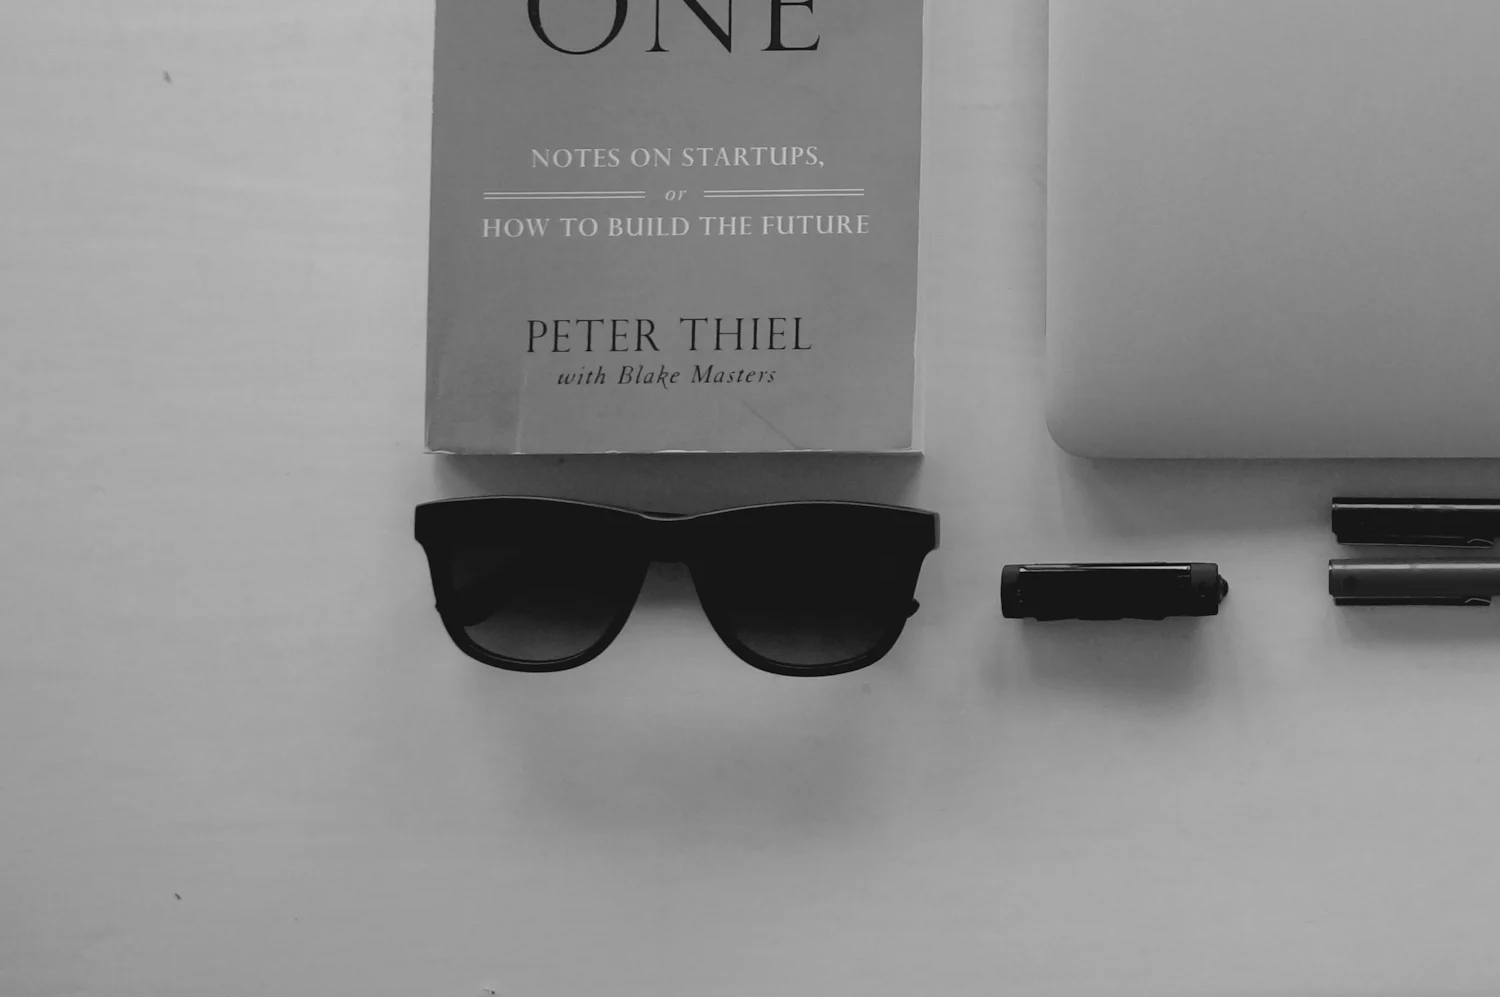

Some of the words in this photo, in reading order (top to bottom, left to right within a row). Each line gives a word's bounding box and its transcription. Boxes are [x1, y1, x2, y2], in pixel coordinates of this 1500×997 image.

[531, 148, 621, 168] NOTES
[630, 147, 672, 168] ON
[682, 145, 825, 168] STARTUPS,
[664, 189, 688, 201] or
[483, 218, 550, 238] HOW
[559, 217, 599, 237] TO
[608, 216, 690, 237] BUILD
[698, 216, 752, 236] THE
[762, 214, 869, 235] FUTURE
[526, 318, 660, 353] PETER
[679, 317, 812, 351] THIEL
[557, 365, 606, 385] with
[617, 364, 681, 390] Blake
[691, 364, 776, 384] Masters
